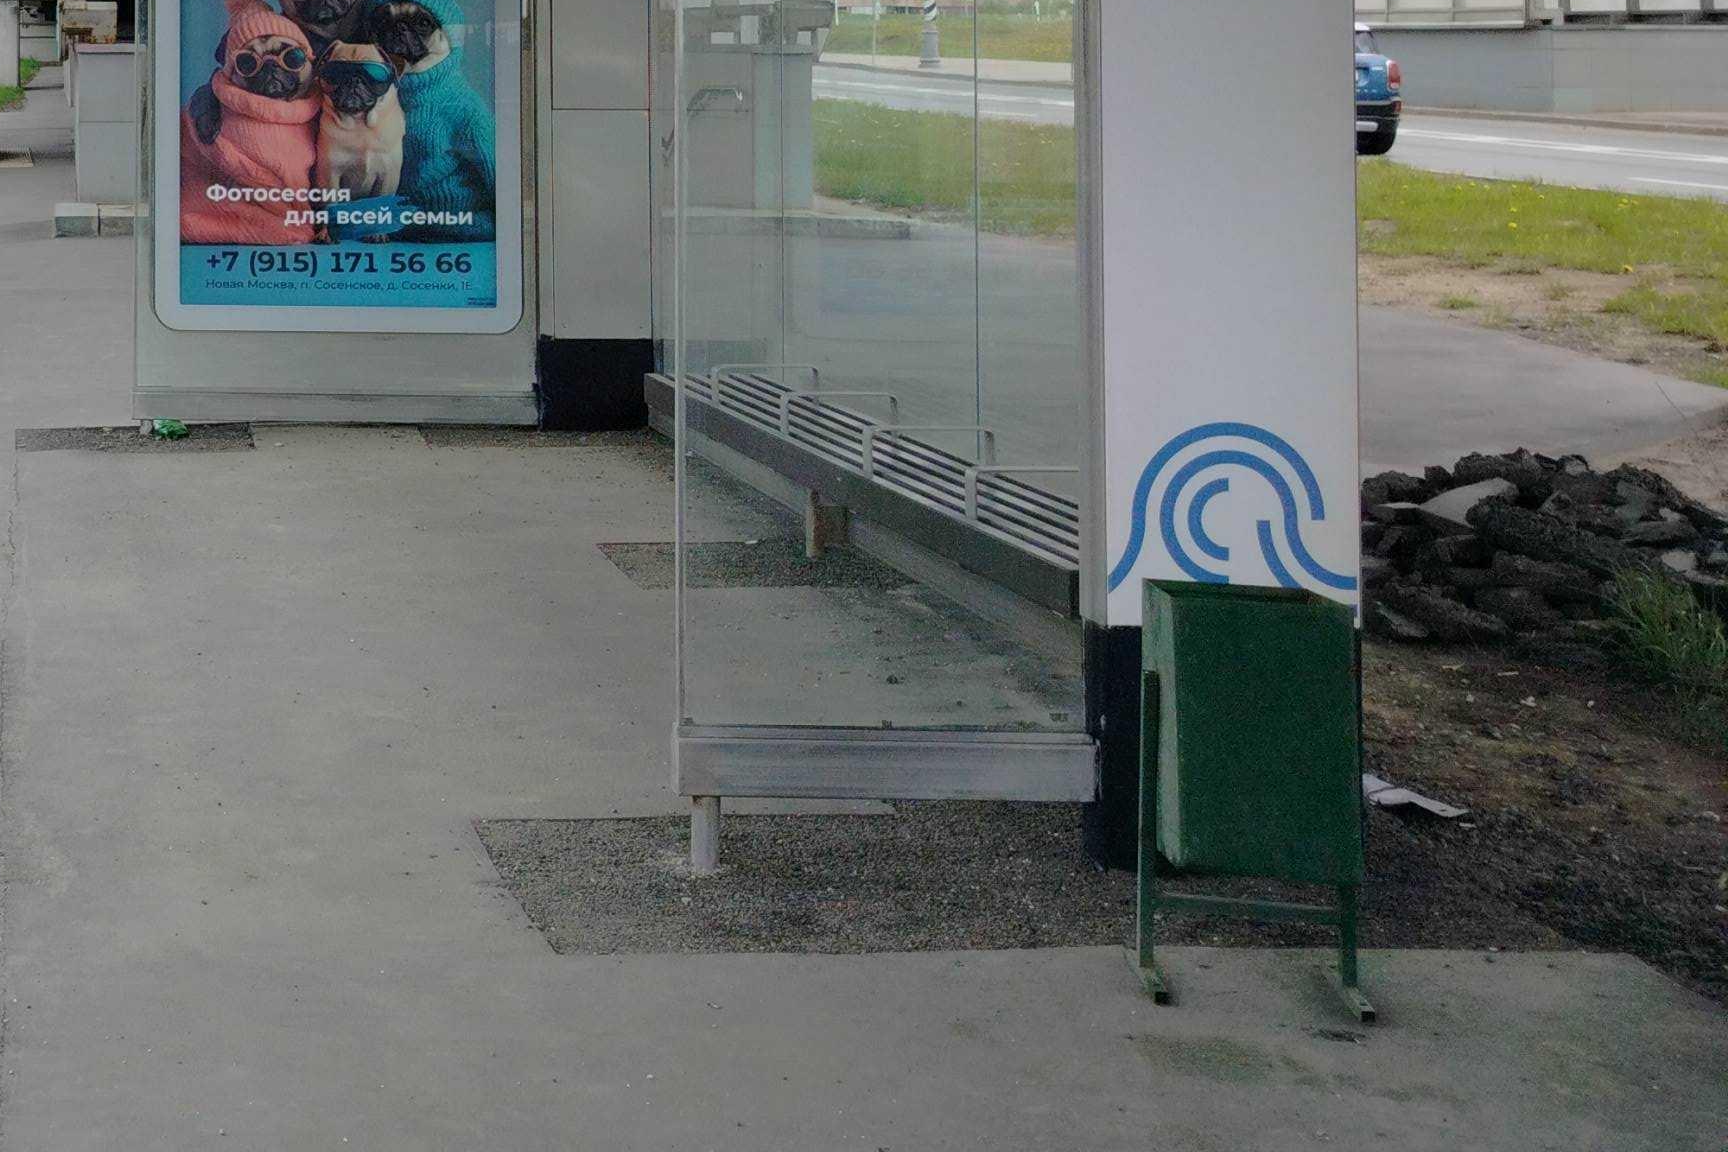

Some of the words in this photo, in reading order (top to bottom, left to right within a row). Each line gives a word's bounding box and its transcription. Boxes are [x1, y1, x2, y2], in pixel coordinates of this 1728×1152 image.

[206, 183, 351, 203] Фотосессия
[284, 209, 329, 226] для
[337, 206, 392, 225] всей
[400, 210, 473, 225] семьи
[206, 252, 238, 273] +7
[249, 251, 318, 277] (915)
[330, 252, 378, 274] 171
[390, 252, 426, 274] 56
[435, 253, 472, 275] 66
[206, 280, 243, 289] Новая
[248, 280, 297, 291] Москва,
